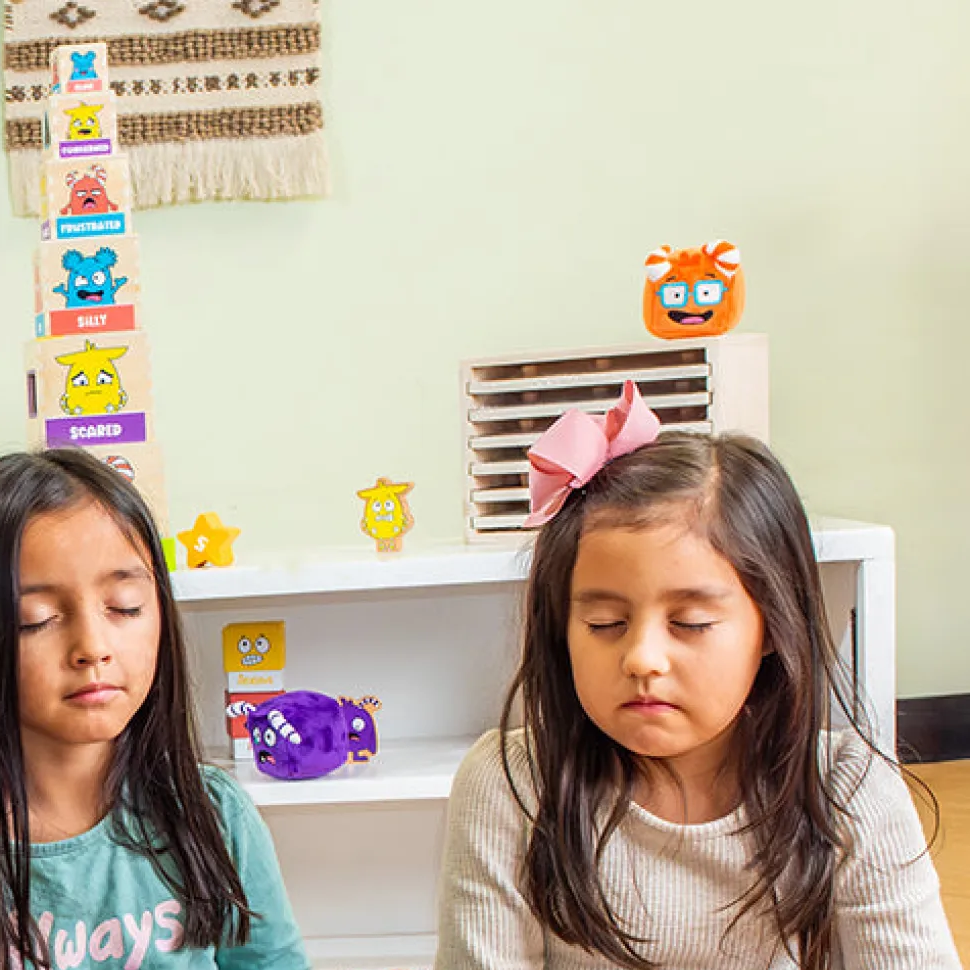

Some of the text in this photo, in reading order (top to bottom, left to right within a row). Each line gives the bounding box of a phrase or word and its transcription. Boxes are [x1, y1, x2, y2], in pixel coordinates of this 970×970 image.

[60, 220, 121, 234] FRUSTRATED
[70, 423, 122, 440] SCARED
[193, 535, 209, 553] S
